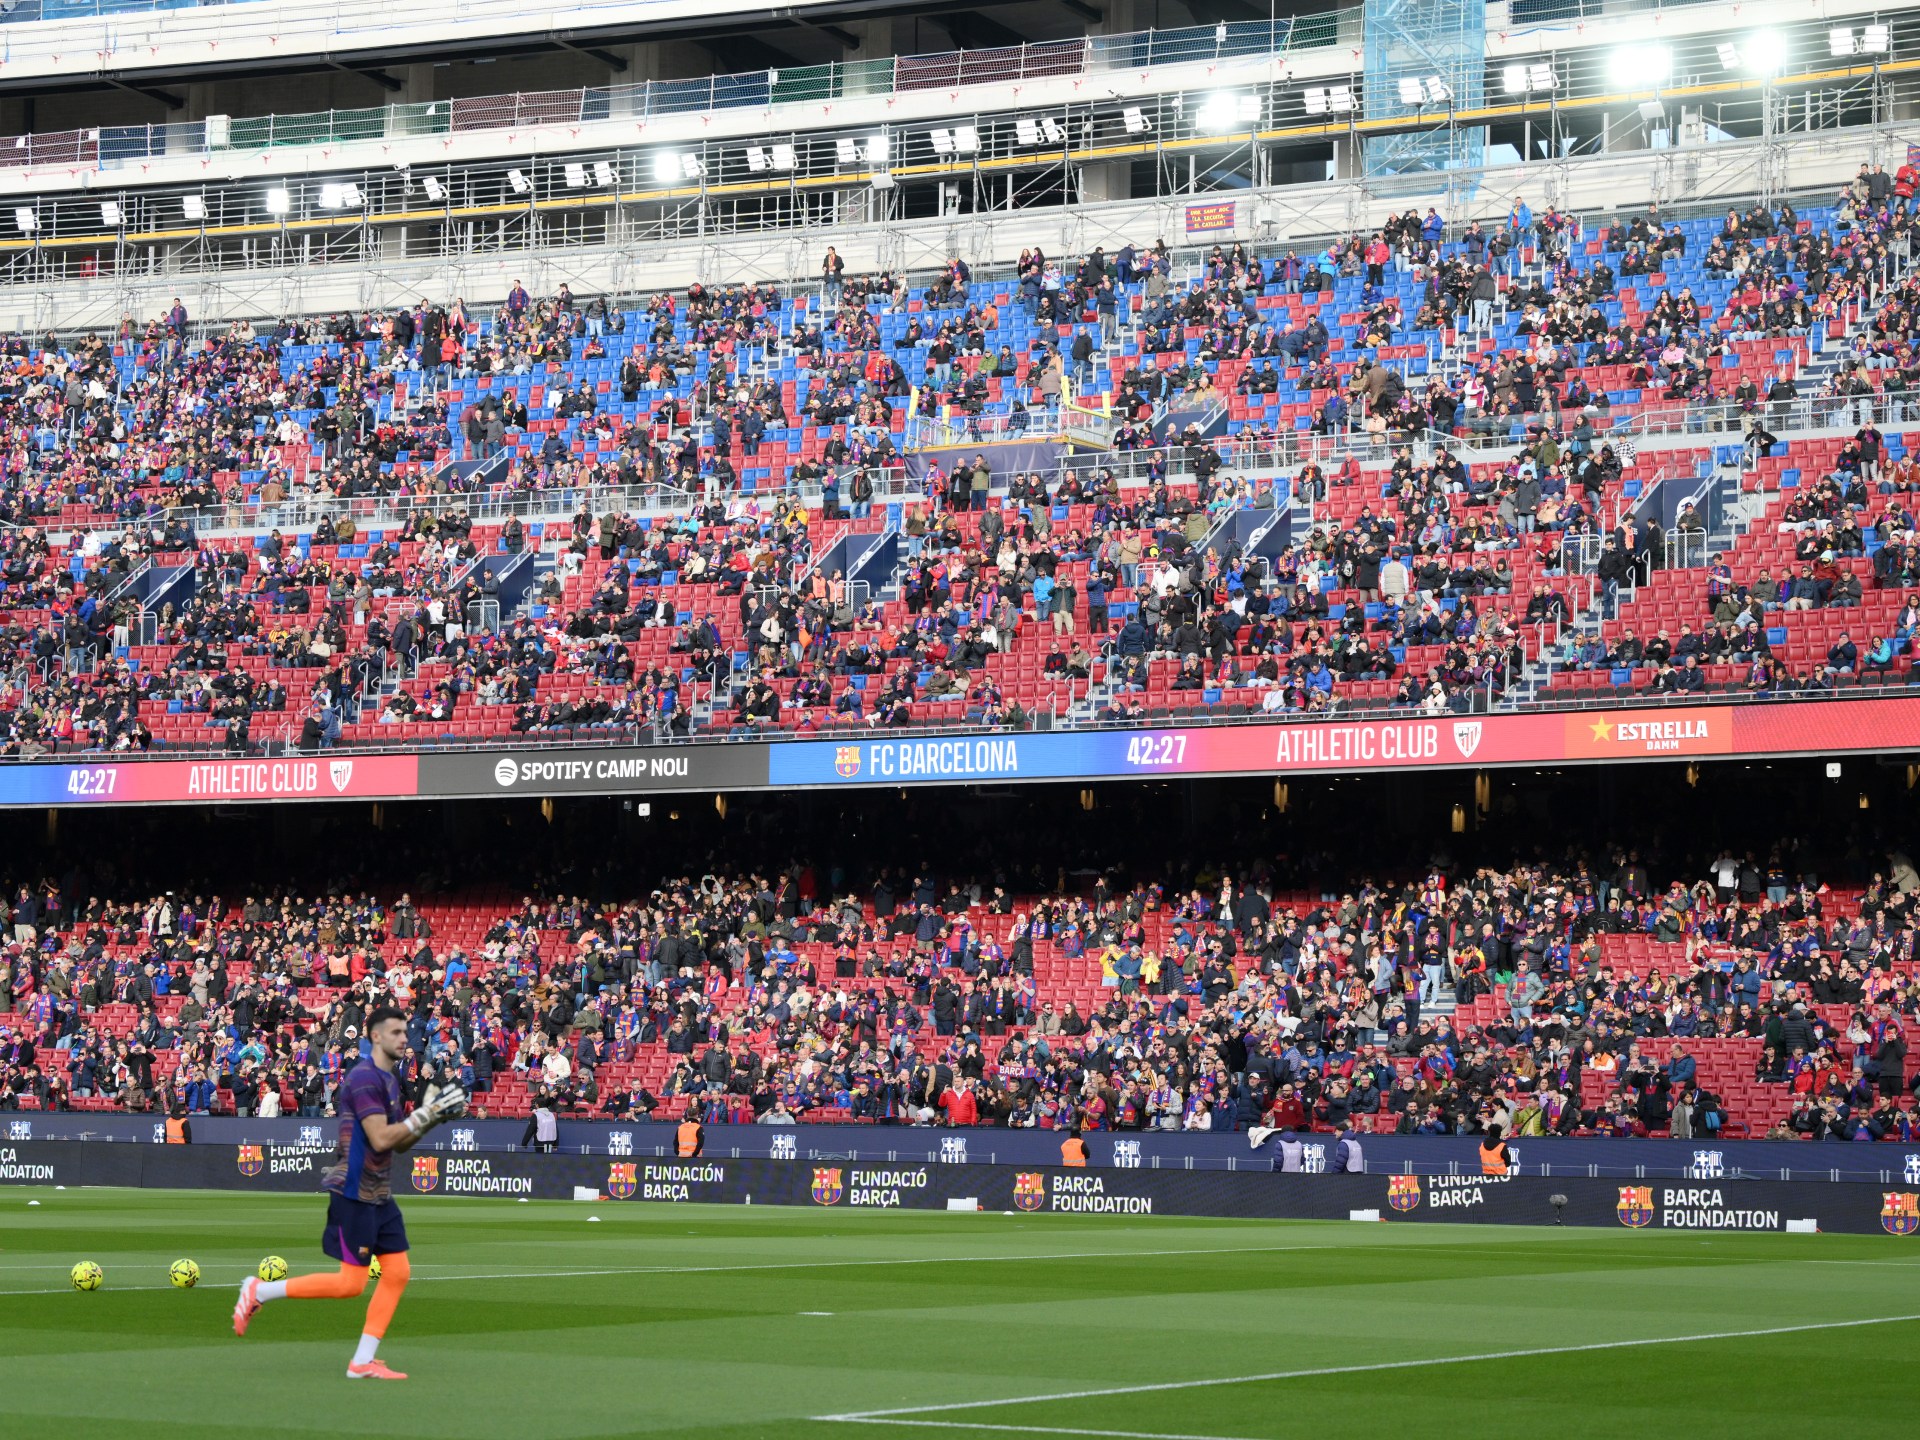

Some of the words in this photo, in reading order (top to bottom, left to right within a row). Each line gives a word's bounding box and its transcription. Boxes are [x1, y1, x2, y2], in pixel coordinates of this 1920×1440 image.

[1617, 720, 1709, 741] ESTRELLA
[1127, 735, 1187, 765] 42:27
[1277, 726, 1375, 763] ATHLETIC
[1381, 724, 1438, 759] CLUB
[1646, 740, 1679, 750] DAMM
[870, 744, 894, 776] FC
[900, 740, 1018, 775] BARCELONA
[188, 764, 267, 794] ATHLETIC
[272, 762, 318, 792] CLUB
[521, 760, 593, 781] SPOTIFY
[596, 759, 647, 778] CAMP
[651, 757, 688, 777] NOU
[67, 769, 117, 795] 42:27
[999, 1066, 1025, 1077] BARÇA
[0, 1148, 17, 1164] ÇA
[270, 1156, 313, 1173] BARÇA
[446, 1159, 491, 1176] BARÇA
[644, 1163, 724, 1182] FUNDACIÓN
[851, 1167, 927, 1188] FUNDACIÓ
[445, 1176, 532, 1192] FOUNDATION
[643, 1183, 689, 1201] BARÇA
[1053, 1176, 1104, 1196] BARÇA
[850, 1189, 900, 1208] BARÇA
[1052, 1195, 1152, 1214] FOUNDATION
[1429, 1187, 1484, 1208] BARÇA
[1663, 1188, 1724, 1210] BARÇA
[1663, 1209, 1779, 1229] FOUNDATION
